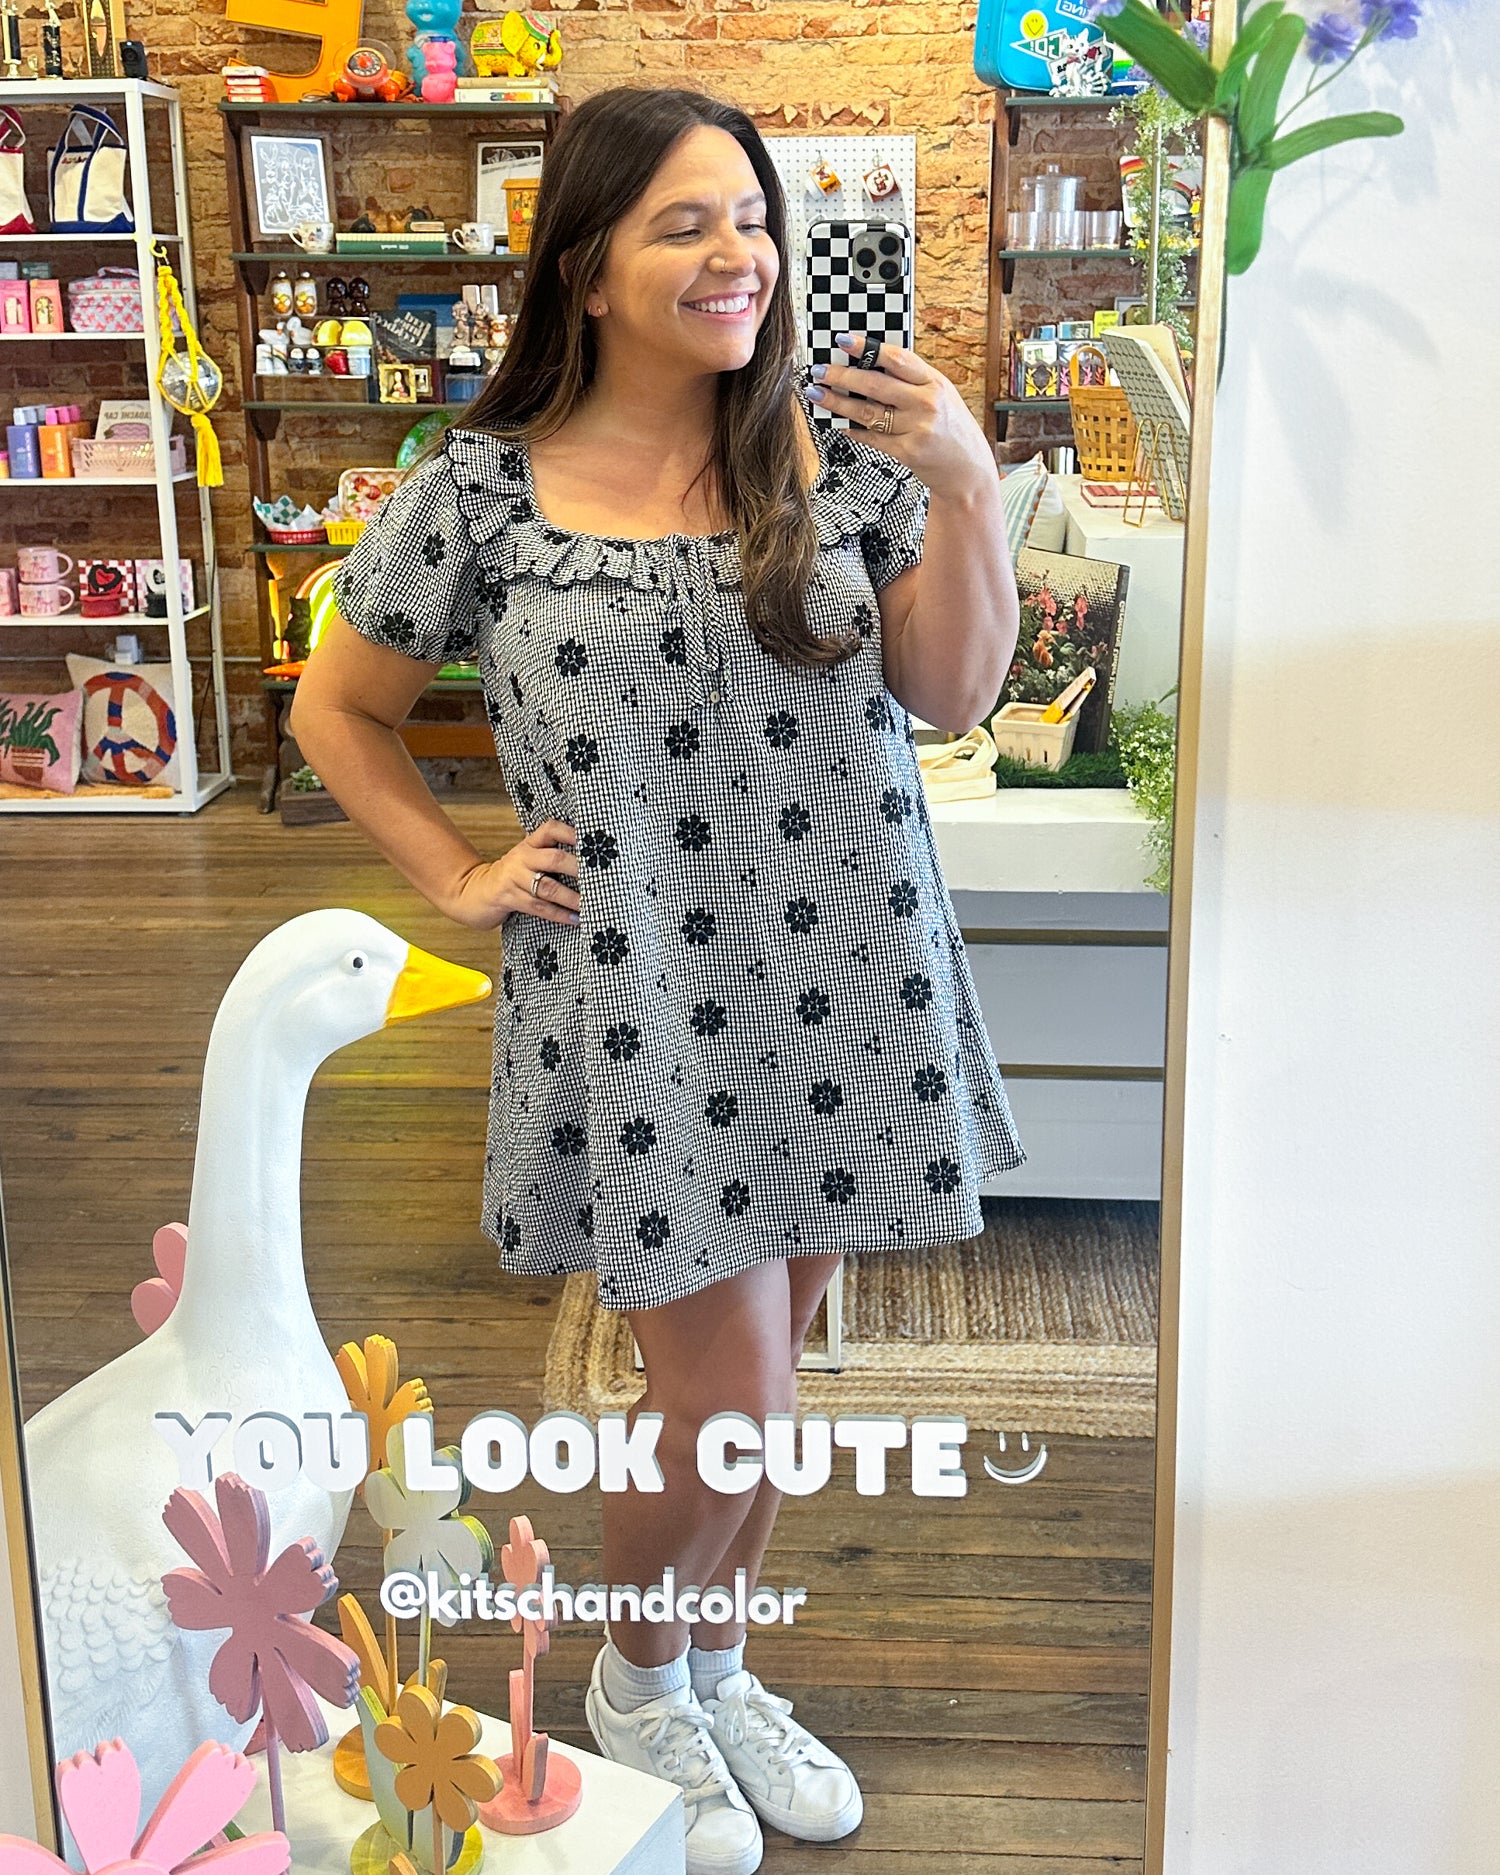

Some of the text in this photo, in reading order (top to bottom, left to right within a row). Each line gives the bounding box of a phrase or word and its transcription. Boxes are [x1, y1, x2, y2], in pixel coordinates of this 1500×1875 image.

[152, 1412, 967, 1497] YOU LOOK CUTE
[380, 1569, 807, 1625] @kitschandcolor
